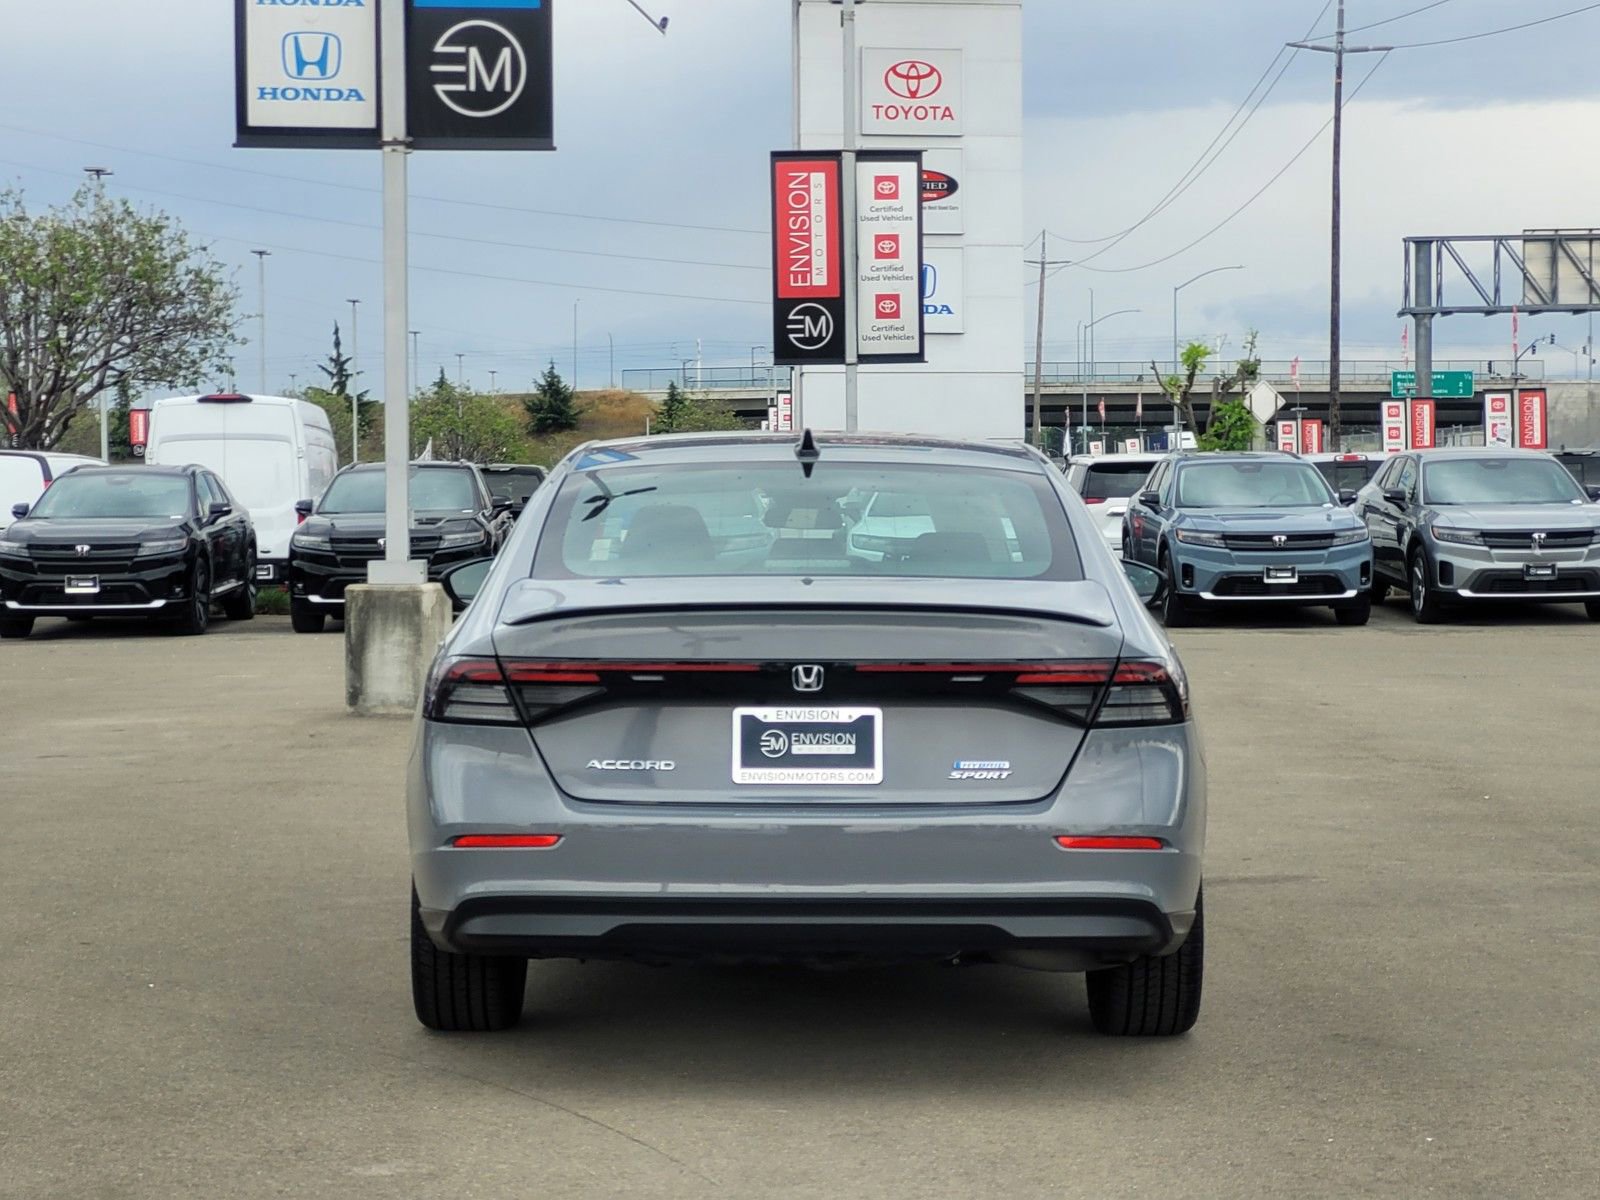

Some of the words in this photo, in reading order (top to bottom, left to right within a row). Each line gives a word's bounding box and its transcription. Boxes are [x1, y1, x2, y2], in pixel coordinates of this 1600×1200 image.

[257, 87, 366, 101] HONDA
[872, 105, 954, 120] TOYOTA
[788, 172, 811, 287] ENVISION
[814, 182, 824, 276] MOTORS
[871, 324, 905, 332] Certified
[1415, 404, 1424, 447] ENVISION
[1523, 397, 1534, 446] ENVISION
[776, 710, 840, 720] ENVISION
[791, 733, 856, 745] ENVISION
[585, 760, 676, 770] ACCORD
[740, 772, 875, 782] ENVISIONMOTORS.COM
[948, 770, 1013, 780] SPORT
